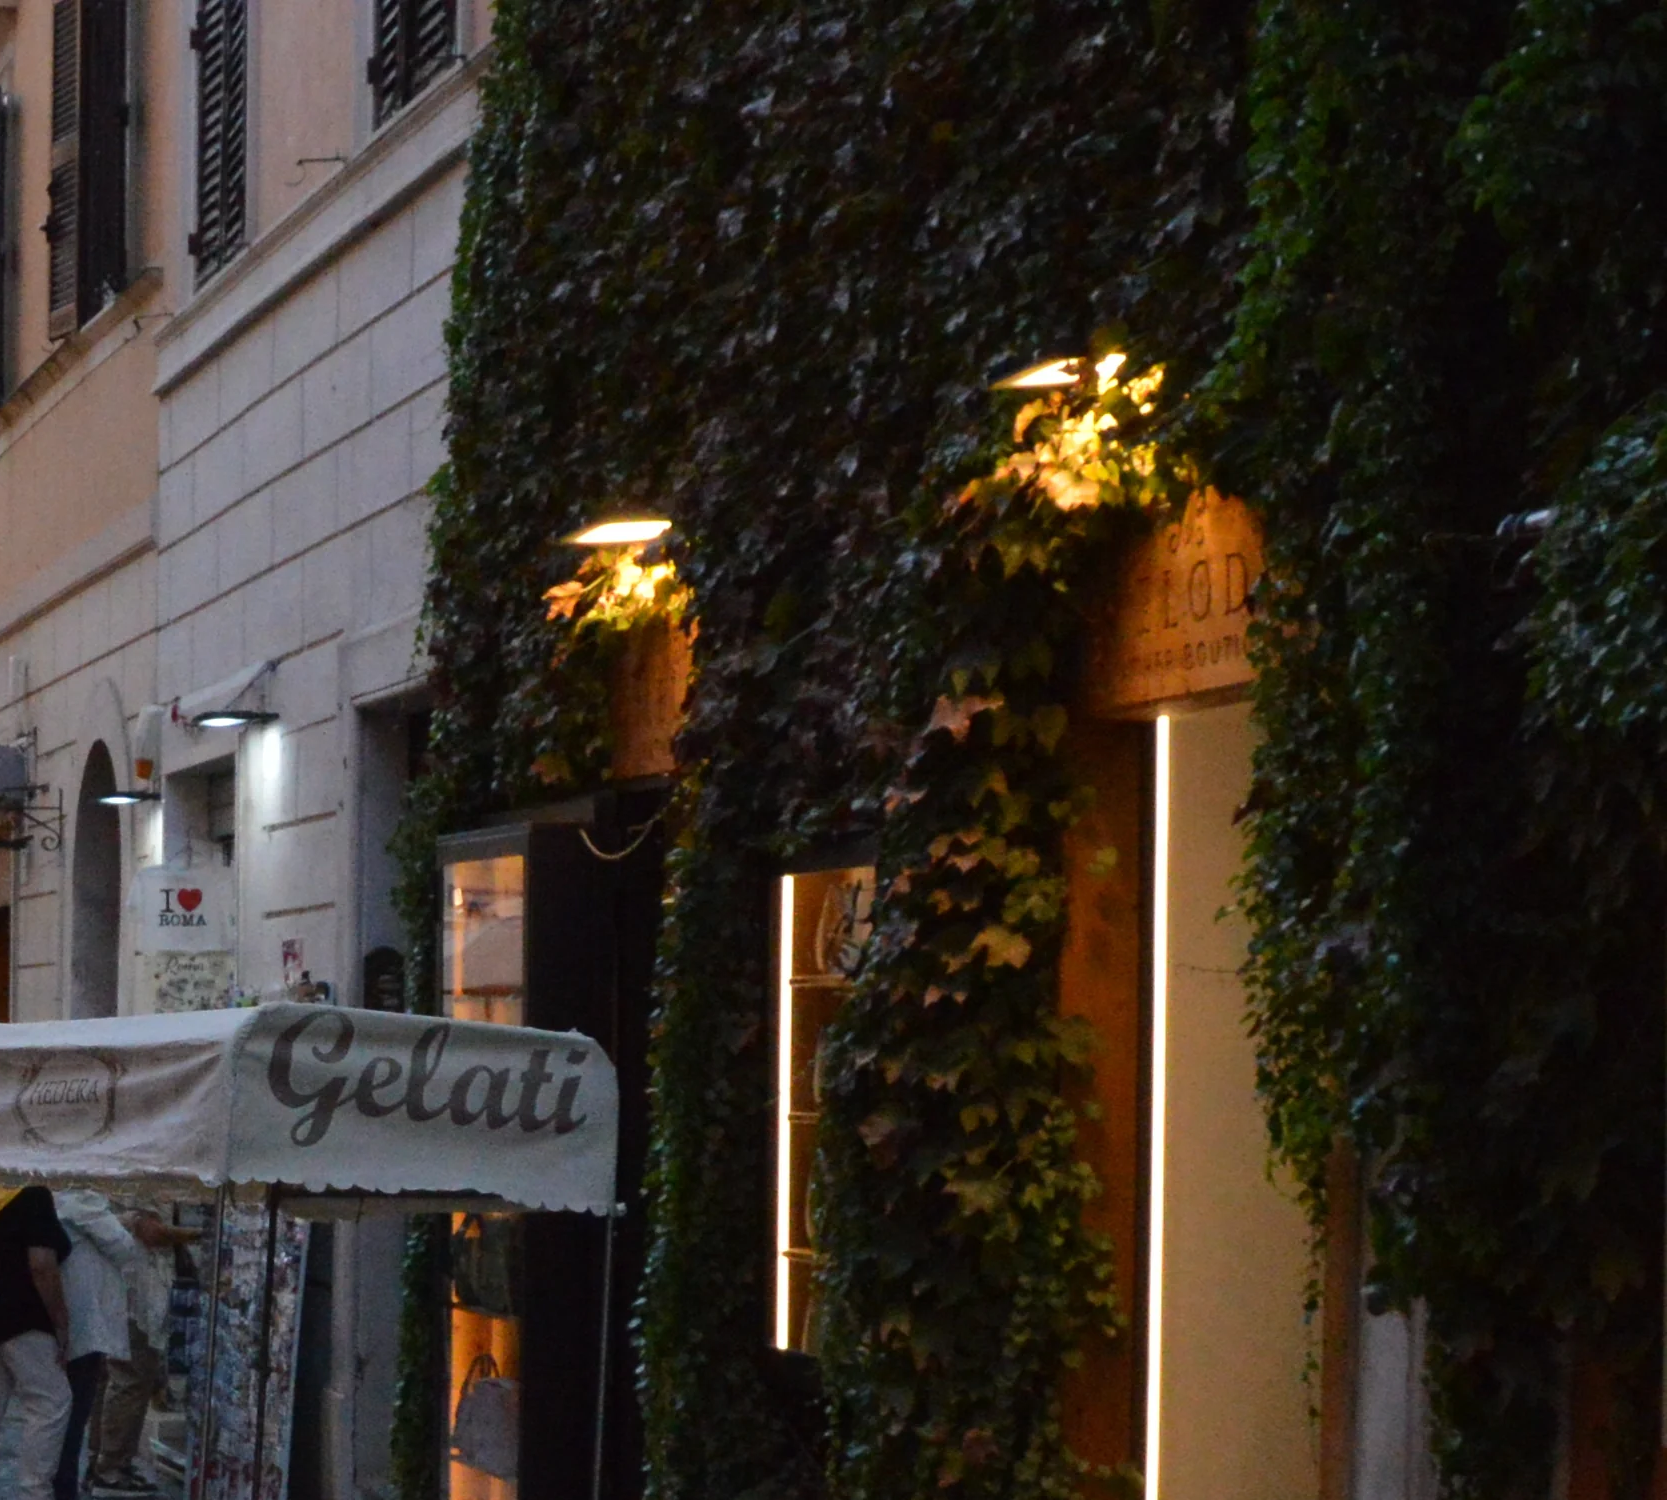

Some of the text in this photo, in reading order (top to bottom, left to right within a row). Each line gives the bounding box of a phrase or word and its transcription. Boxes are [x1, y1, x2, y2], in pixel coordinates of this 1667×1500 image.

[160, 889, 174, 913] I
[158, 914, 207, 927] ROMA
[269, 1010, 589, 1147] Gelati
[29, 1078, 99, 1105] HEDERA
